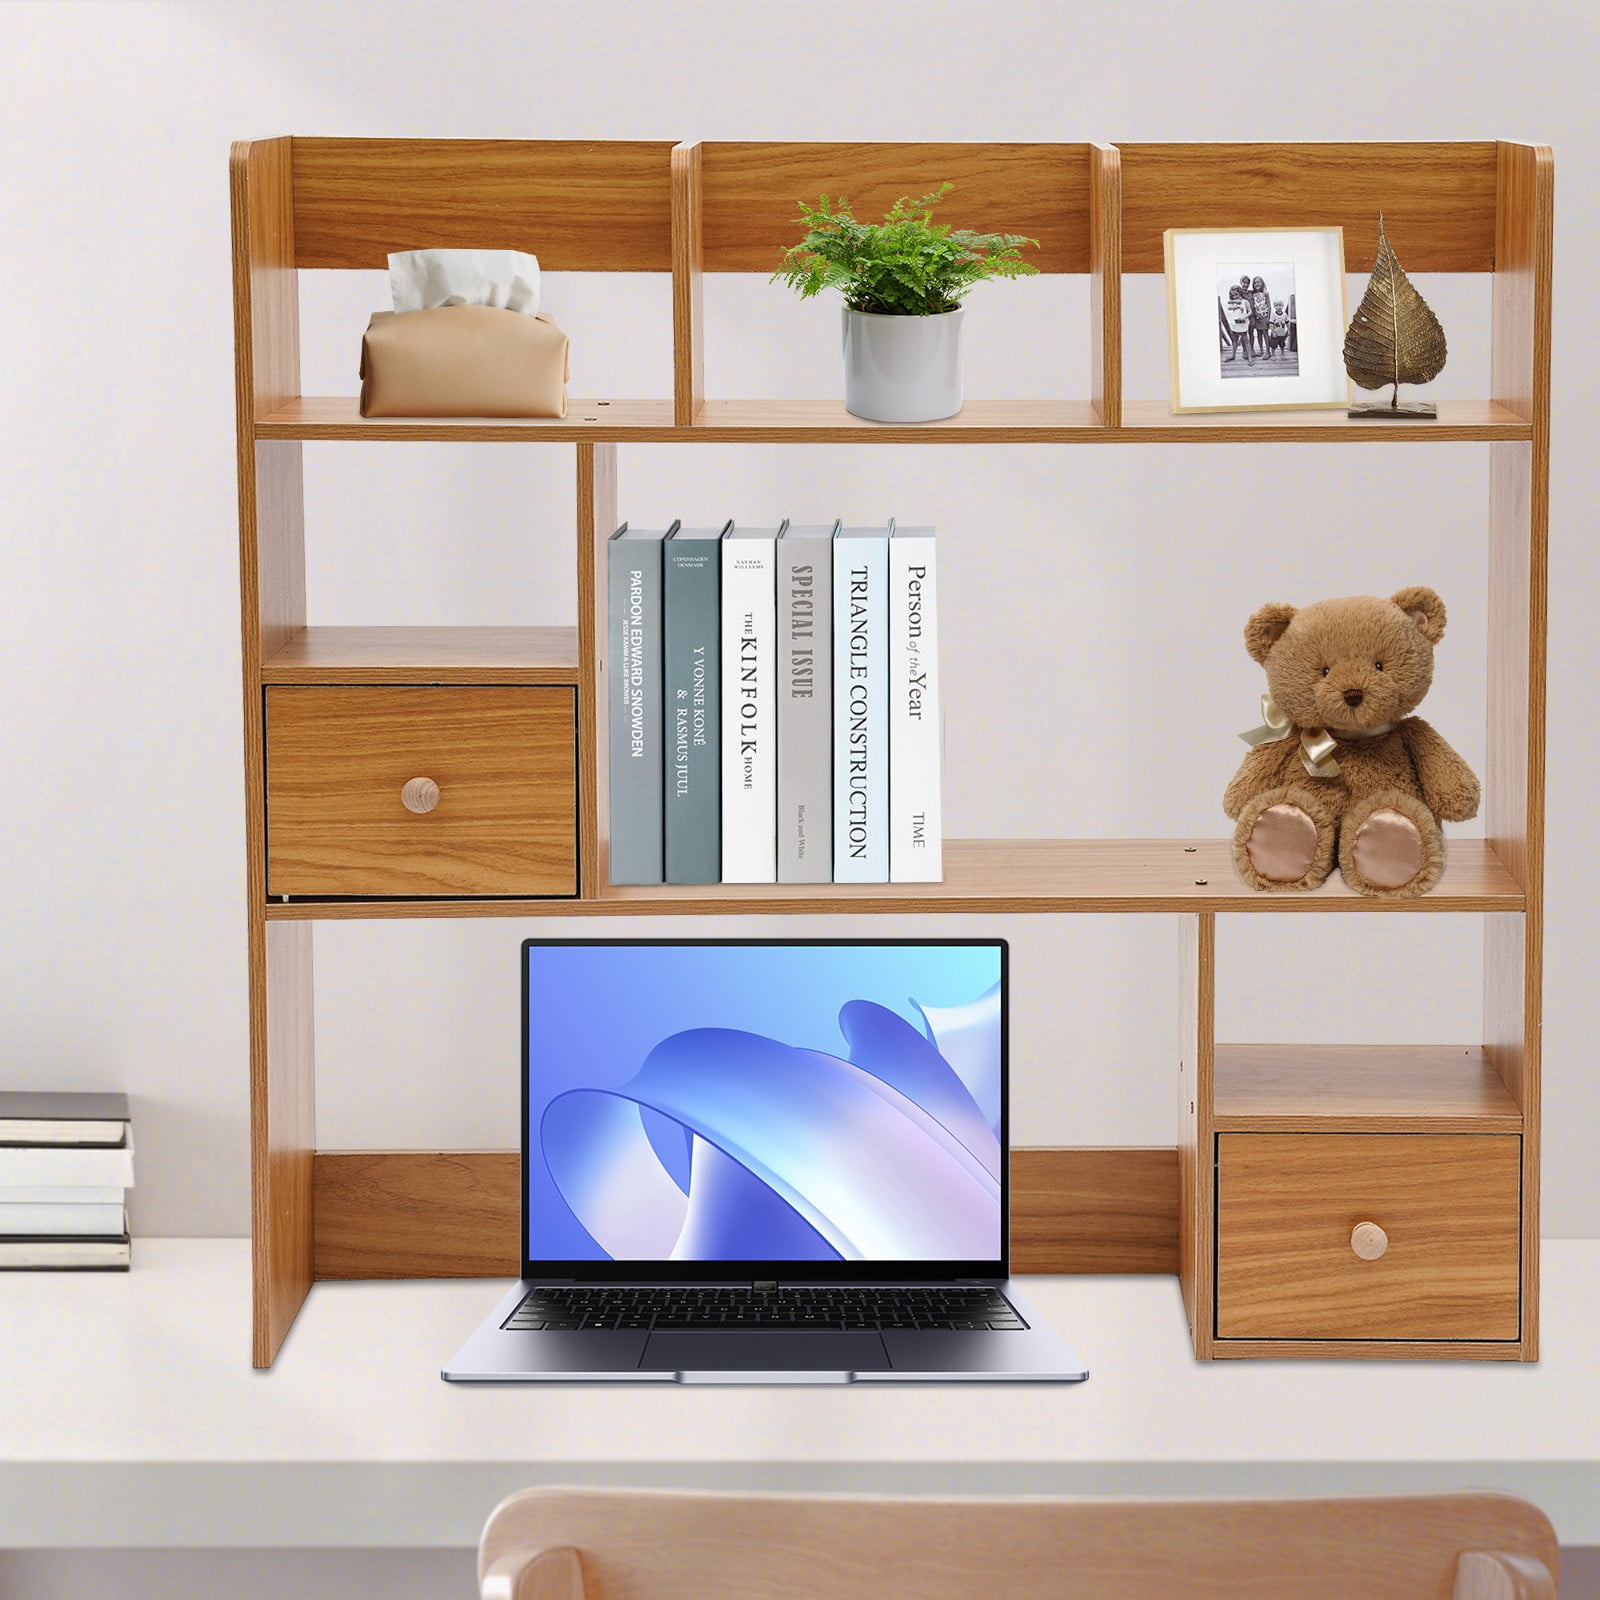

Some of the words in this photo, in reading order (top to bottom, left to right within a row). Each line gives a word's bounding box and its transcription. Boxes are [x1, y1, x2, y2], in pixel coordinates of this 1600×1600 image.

[630, 570, 643, 625] PARDON
[791, 565, 814, 640] SPECIAL
[849, 565, 868, 679] TRIANGLE
[908, 566, 926, 638] Person
[744, 612, 753, 635] THE
[906, 640, 920, 653] of
[630, 629, 643, 687] EDWARD
[791, 649, 814, 698] ISSUE
[908, 657, 920, 677] the
[676, 688, 688, 700] &
[741, 637, 757, 755] KINFOLK
[908, 672, 927, 720] Year
[631, 689, 644, 757] SNOWDEN
[676, 708, 688, 762] RASMUS
[694, 709, 707, 746] KONÉ
[675, 764, 688, 797] JUUL
[744, 757, 753, 790] HOME
[849, 684, 868, 859] CONSTRUCTION
[912, 812, 926, 849] TIME
